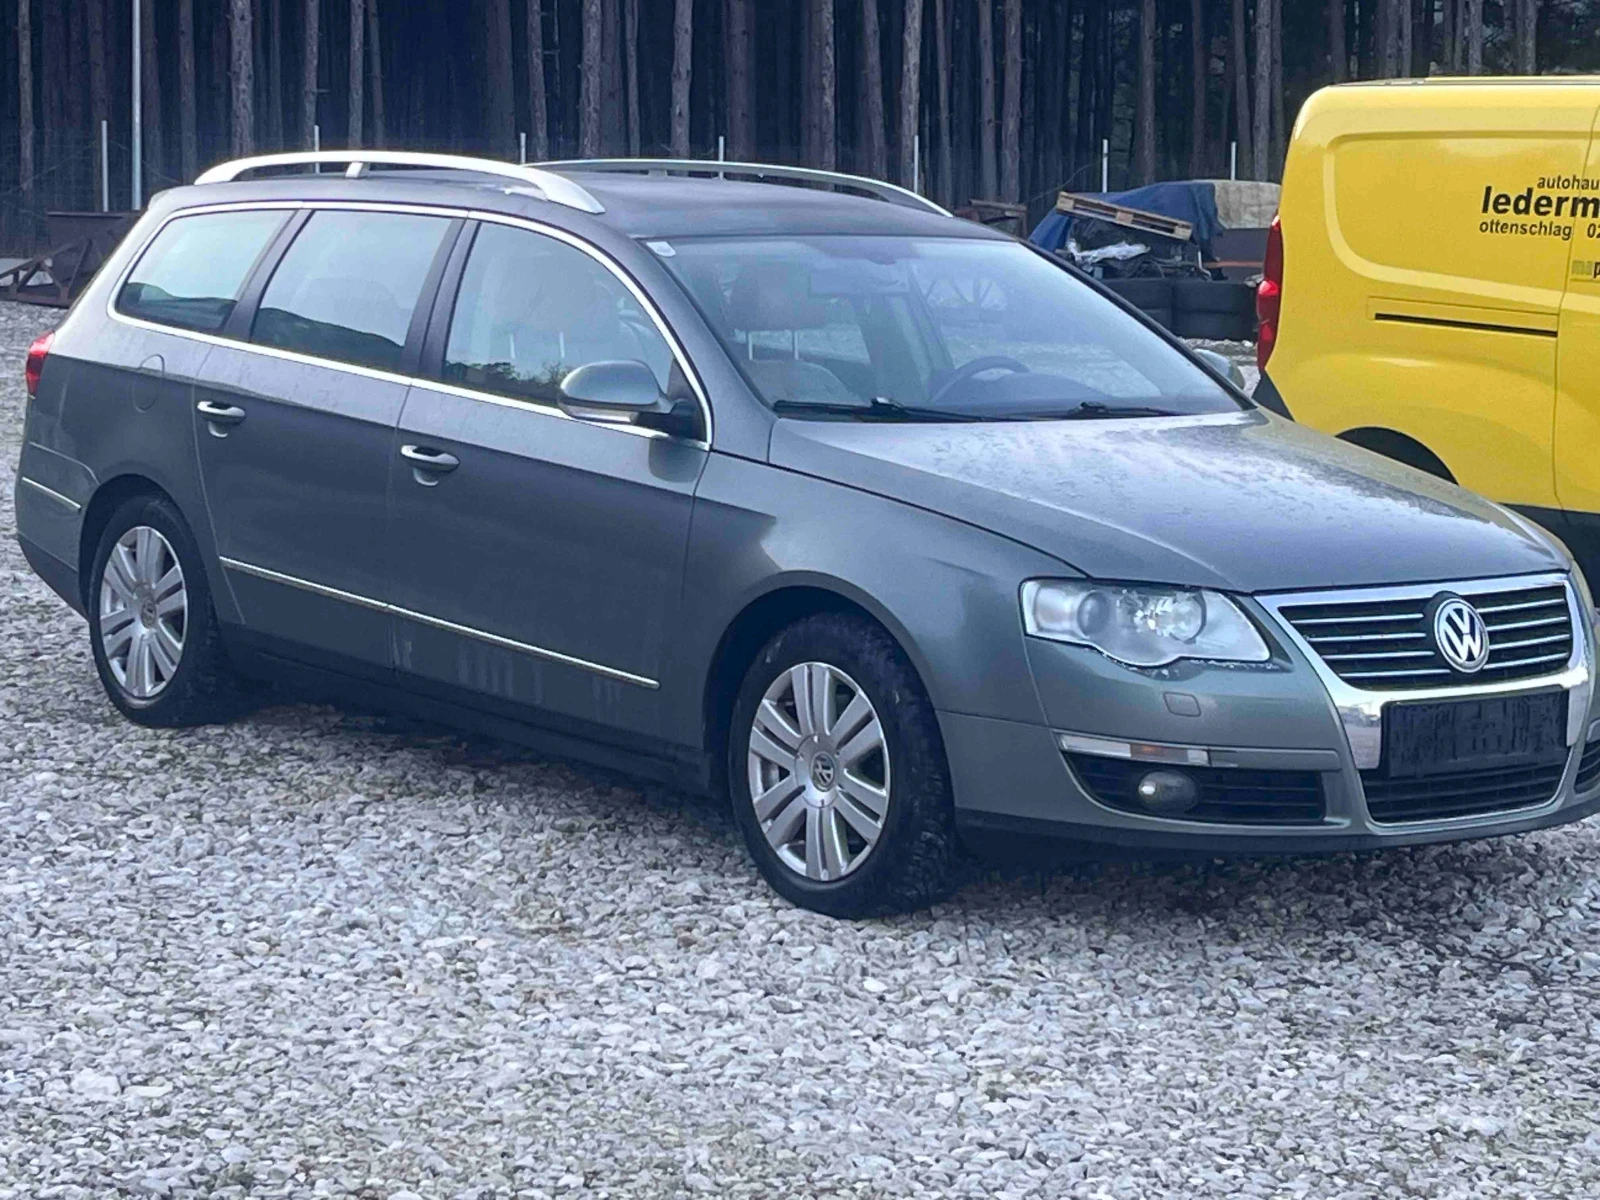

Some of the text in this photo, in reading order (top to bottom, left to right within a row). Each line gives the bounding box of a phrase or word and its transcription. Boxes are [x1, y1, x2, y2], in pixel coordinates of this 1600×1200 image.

[1537, 175, 1600, 190] autohau
[1482, 186, 1600, 218] lederm
[1479, 219, 1572, 240] ottenschlag
